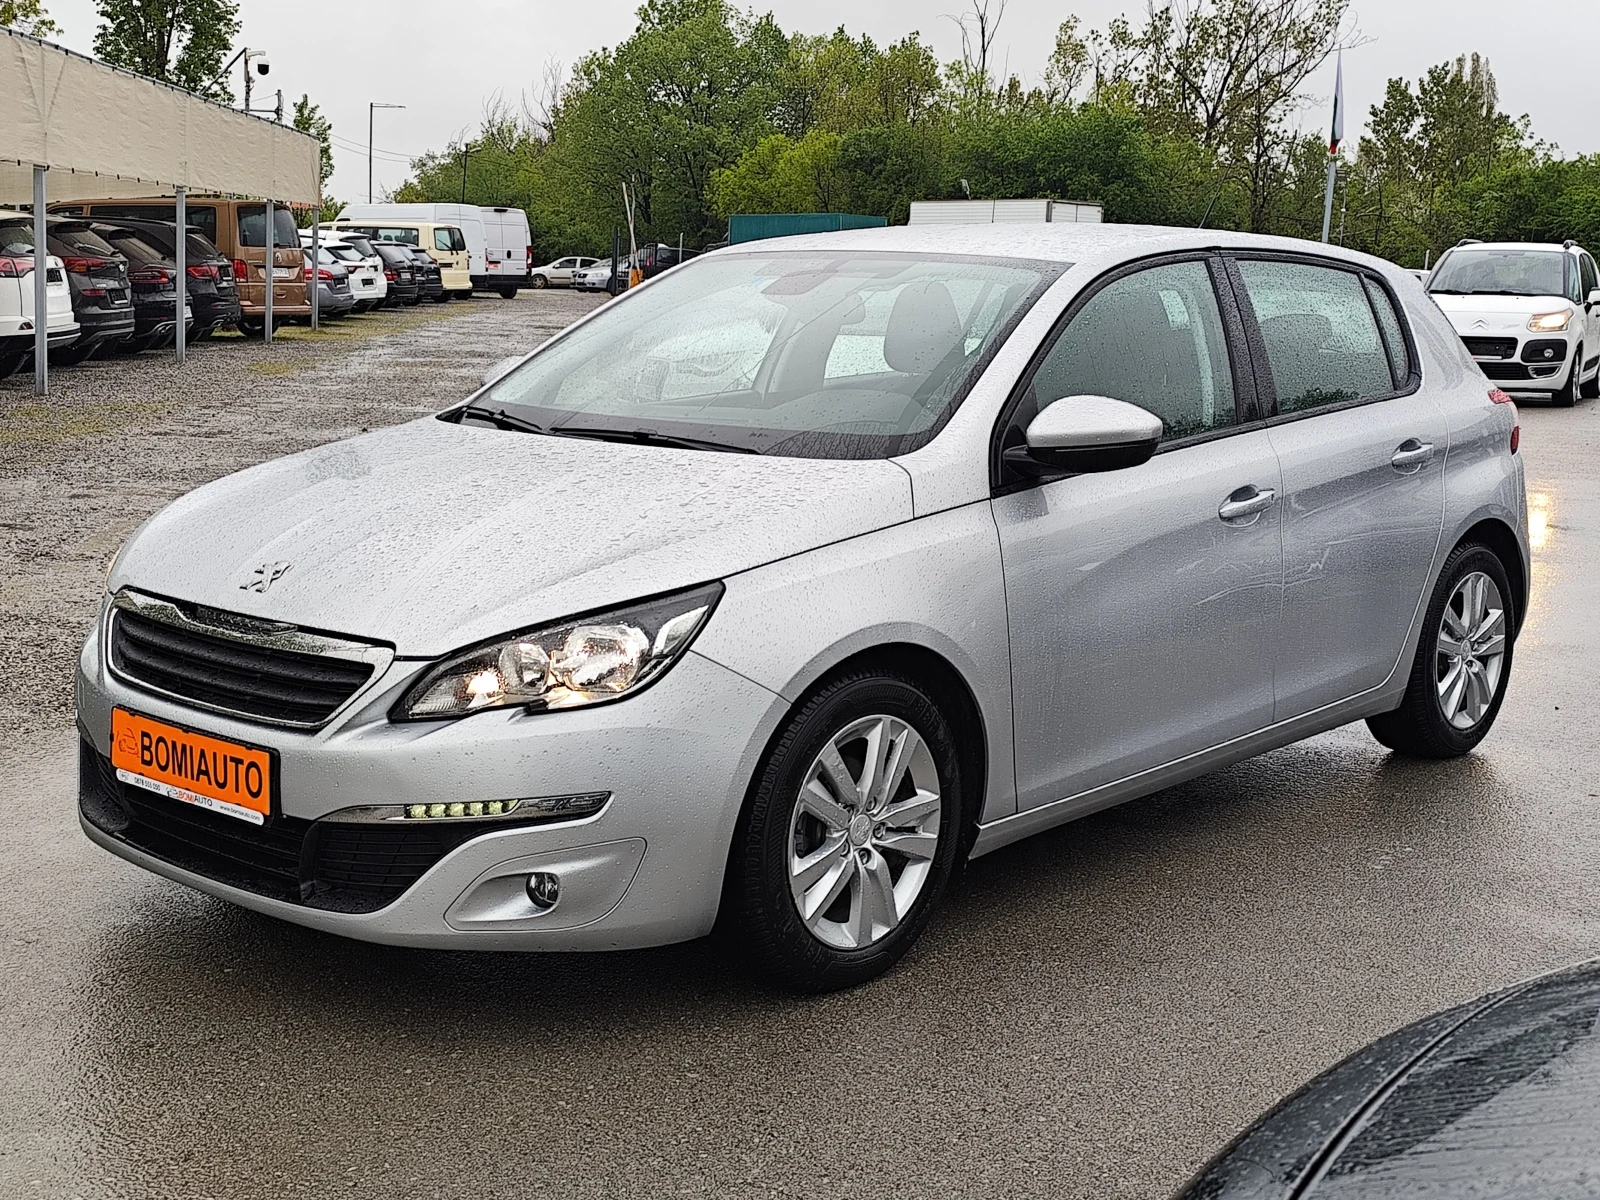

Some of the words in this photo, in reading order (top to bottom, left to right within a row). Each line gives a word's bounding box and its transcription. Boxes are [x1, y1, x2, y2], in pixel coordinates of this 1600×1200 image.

[140, 730, 263, 799] BOMIAUTO
[178, 790, 213, 807] BOMIAUTO
[219, 804, 261, 822] www.bomiauto.com
